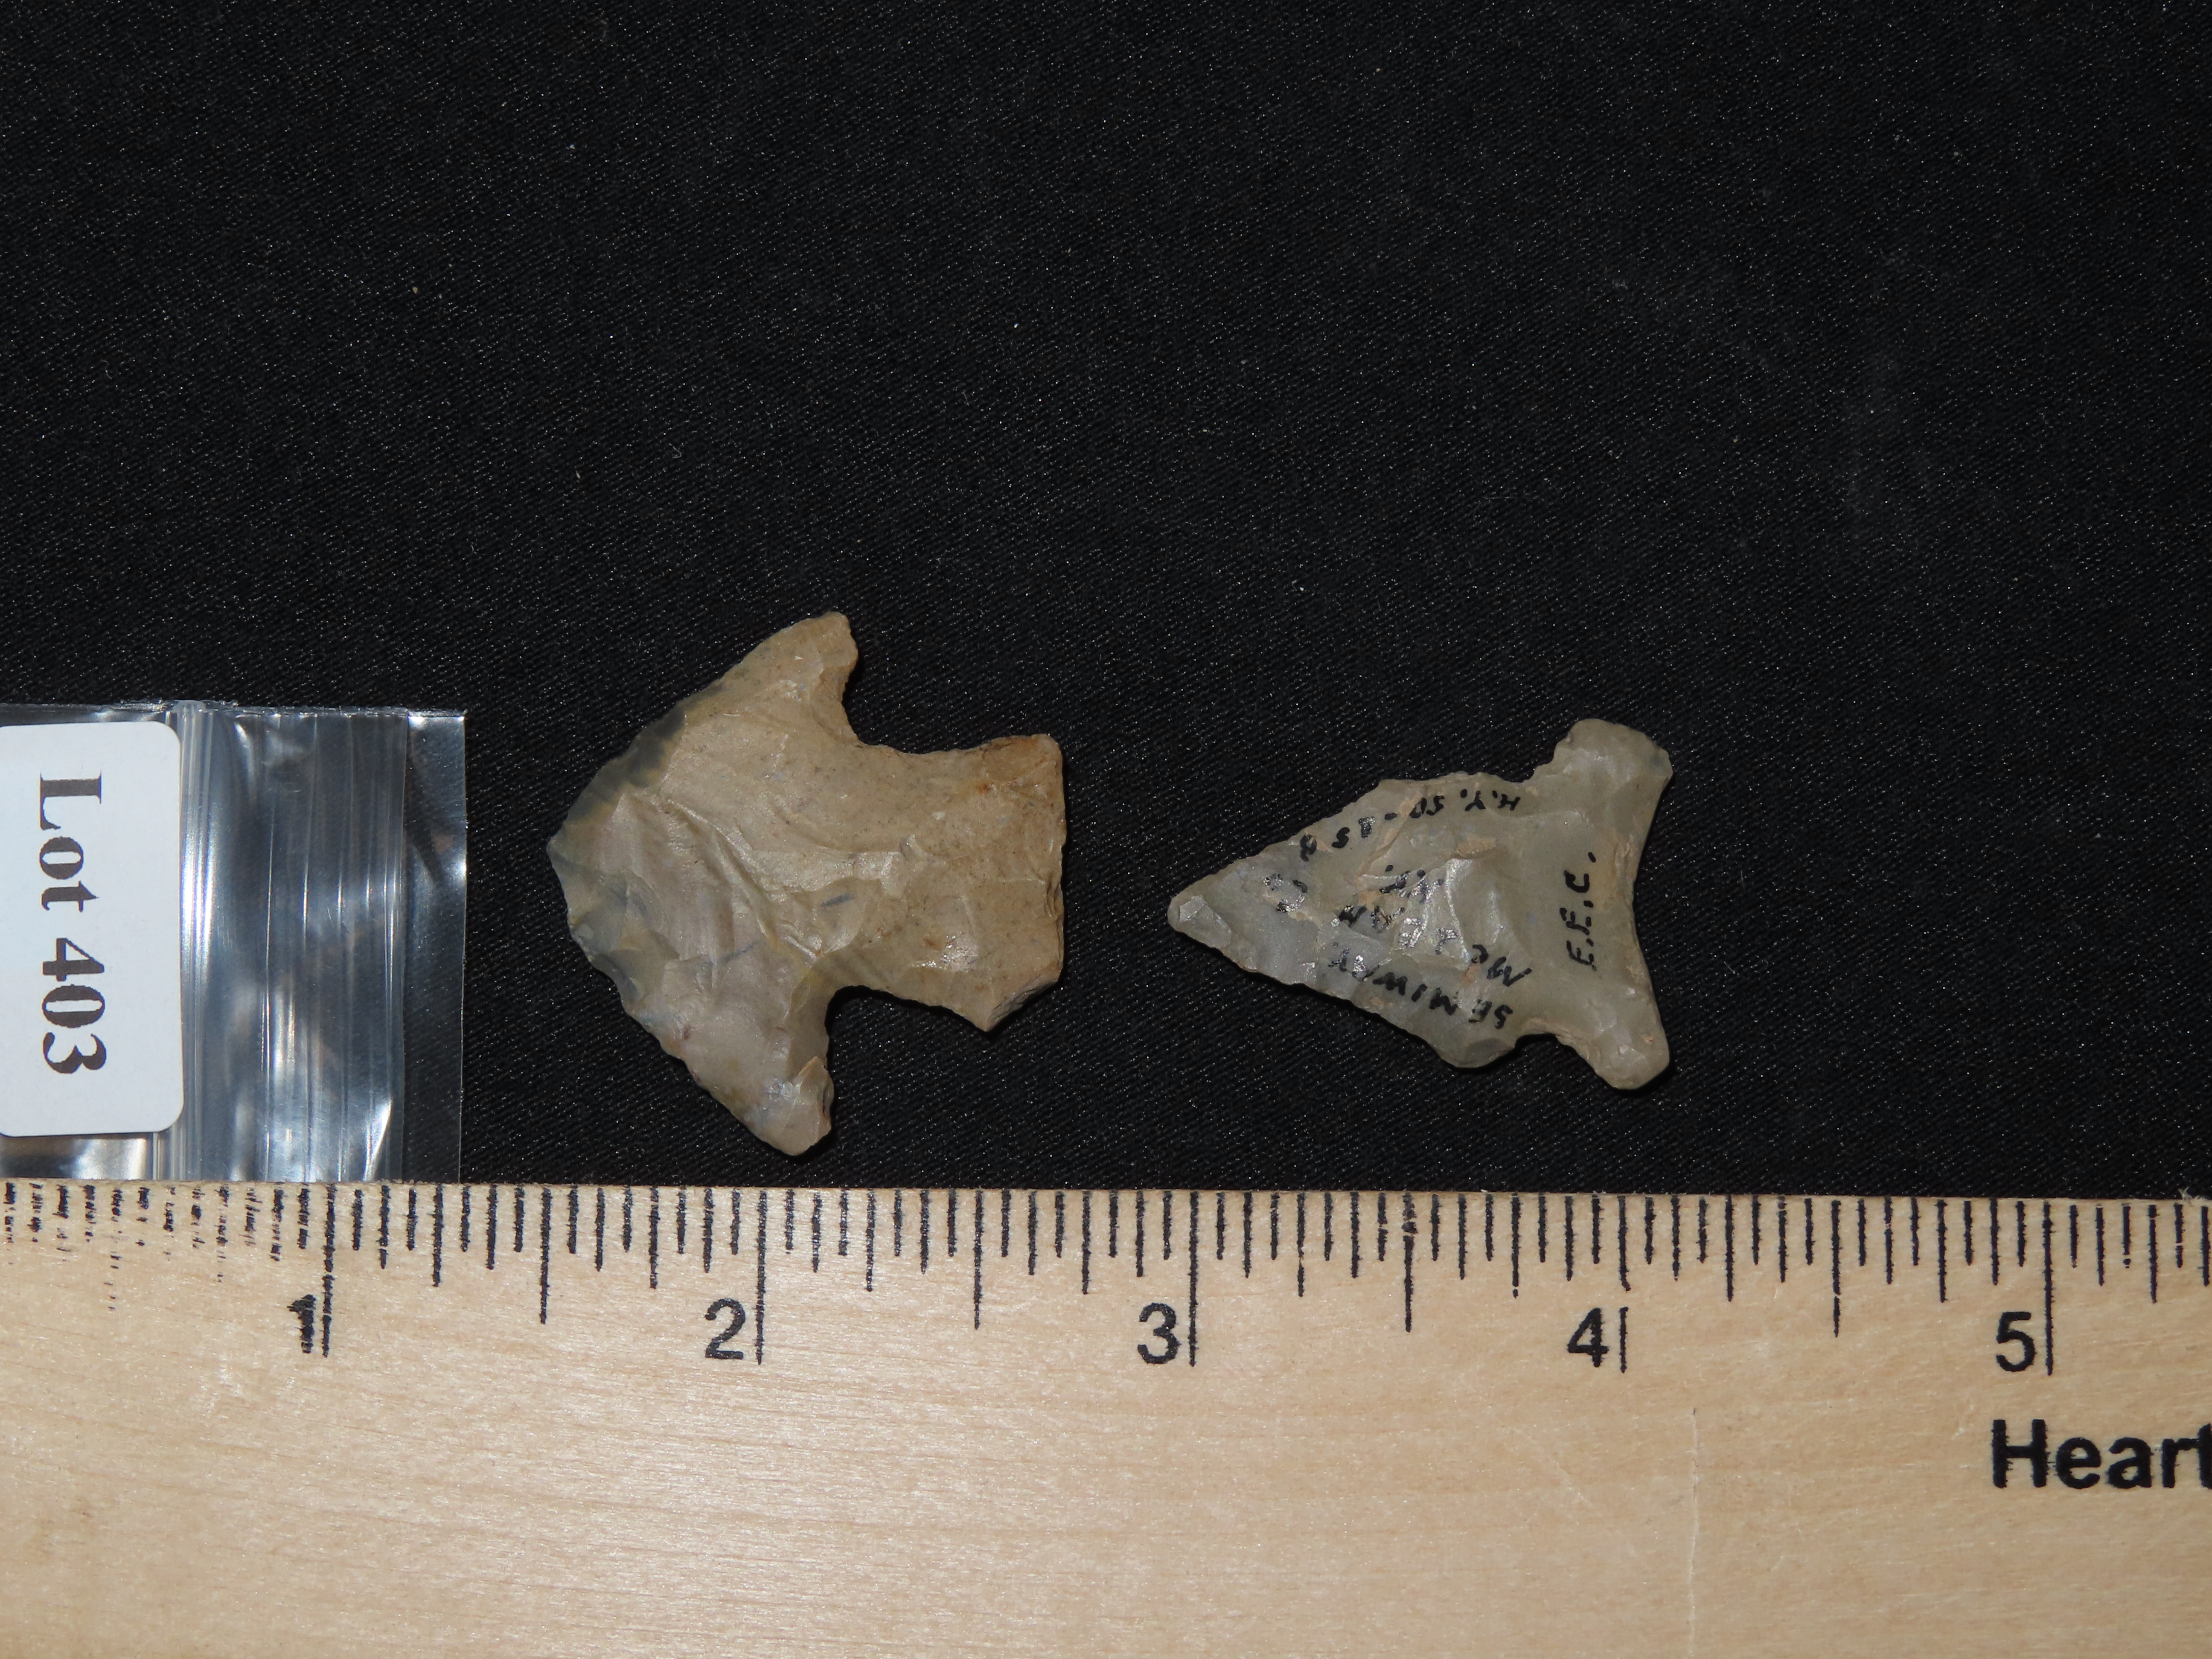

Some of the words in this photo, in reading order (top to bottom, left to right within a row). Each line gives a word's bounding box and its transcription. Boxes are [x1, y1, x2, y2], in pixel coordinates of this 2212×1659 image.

[39, 770, 102, 913] Lot
[42, 937, 107, 1074] 403
[287, 1294, 316, 1354] 1
[705, 1298, 746, 1360] 2
[1137, 1303, 1180, 1365] 3
[1567, 1307, 1609, 1368] 4
[1996, 1311, 2037, 1372] 5
[1991, 1419, 2212, 1490] Heart
